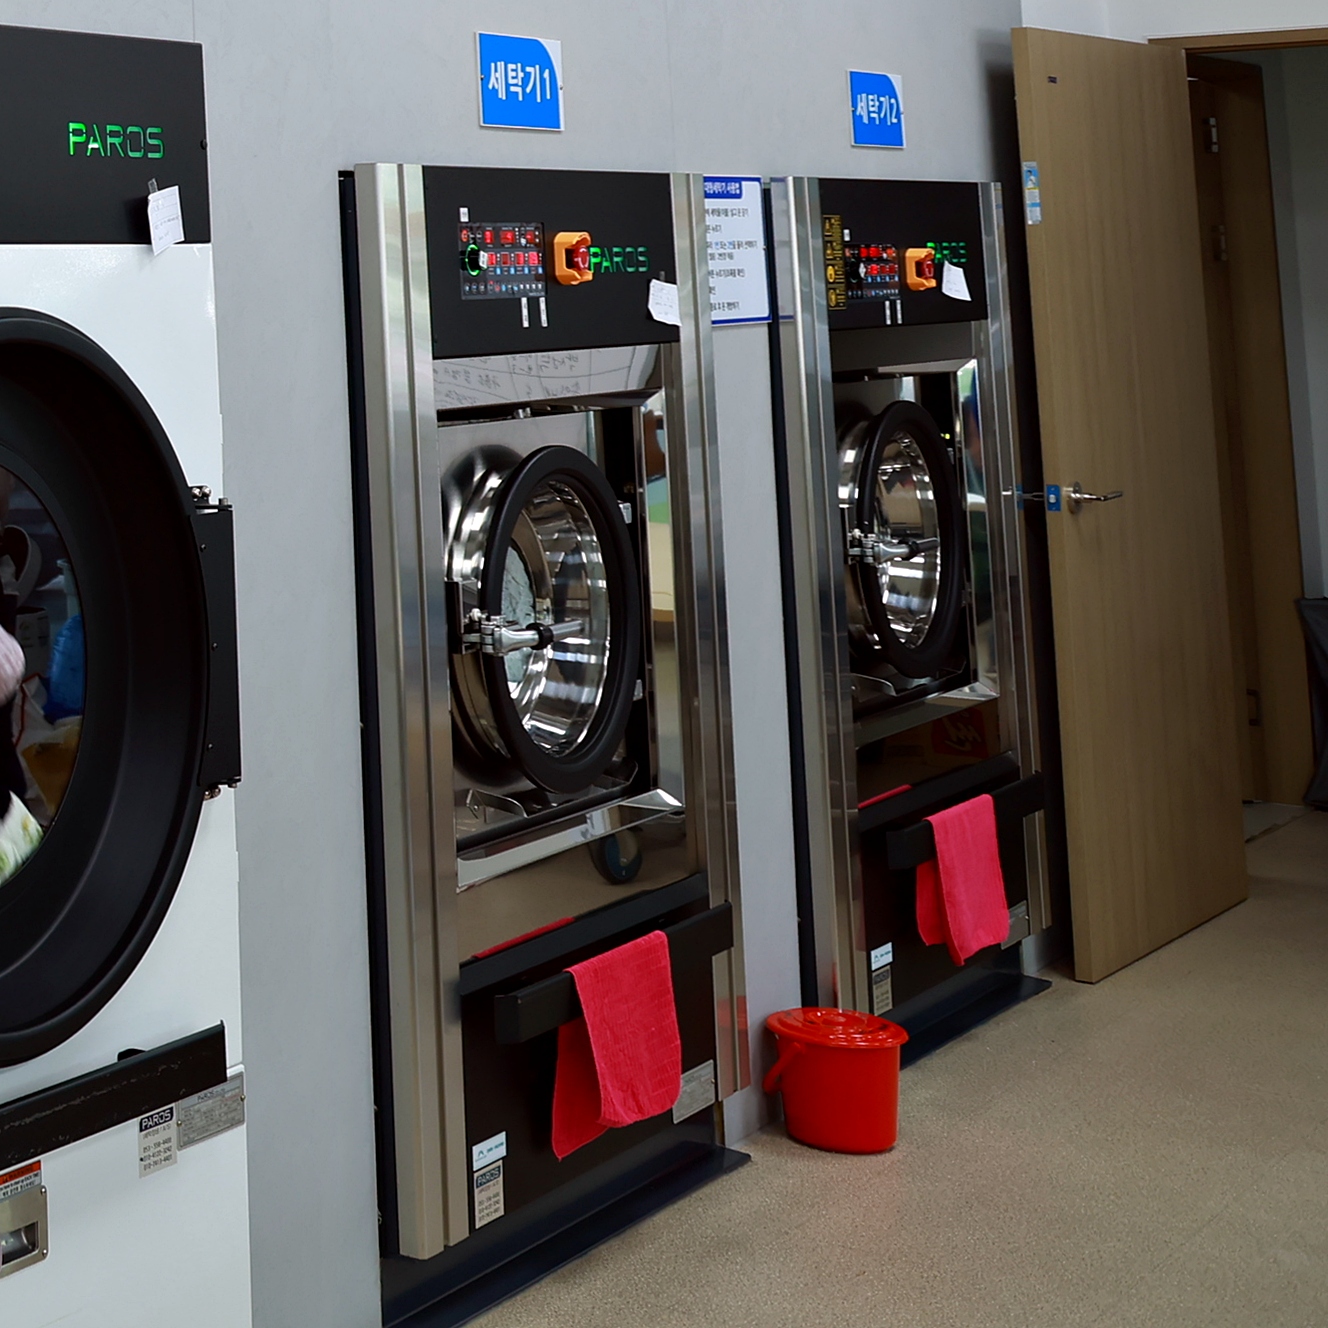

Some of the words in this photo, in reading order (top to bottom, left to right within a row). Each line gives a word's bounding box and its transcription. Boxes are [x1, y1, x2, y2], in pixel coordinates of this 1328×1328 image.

[488, 61, 550, 103] 세탁기1
[856, 94, 898, 125] 세탁기2
[67, 121, 165, 159] PAROS
[589, 247, 649, 273] PAROS
[142, 1109, 171, 1130] PAROS
